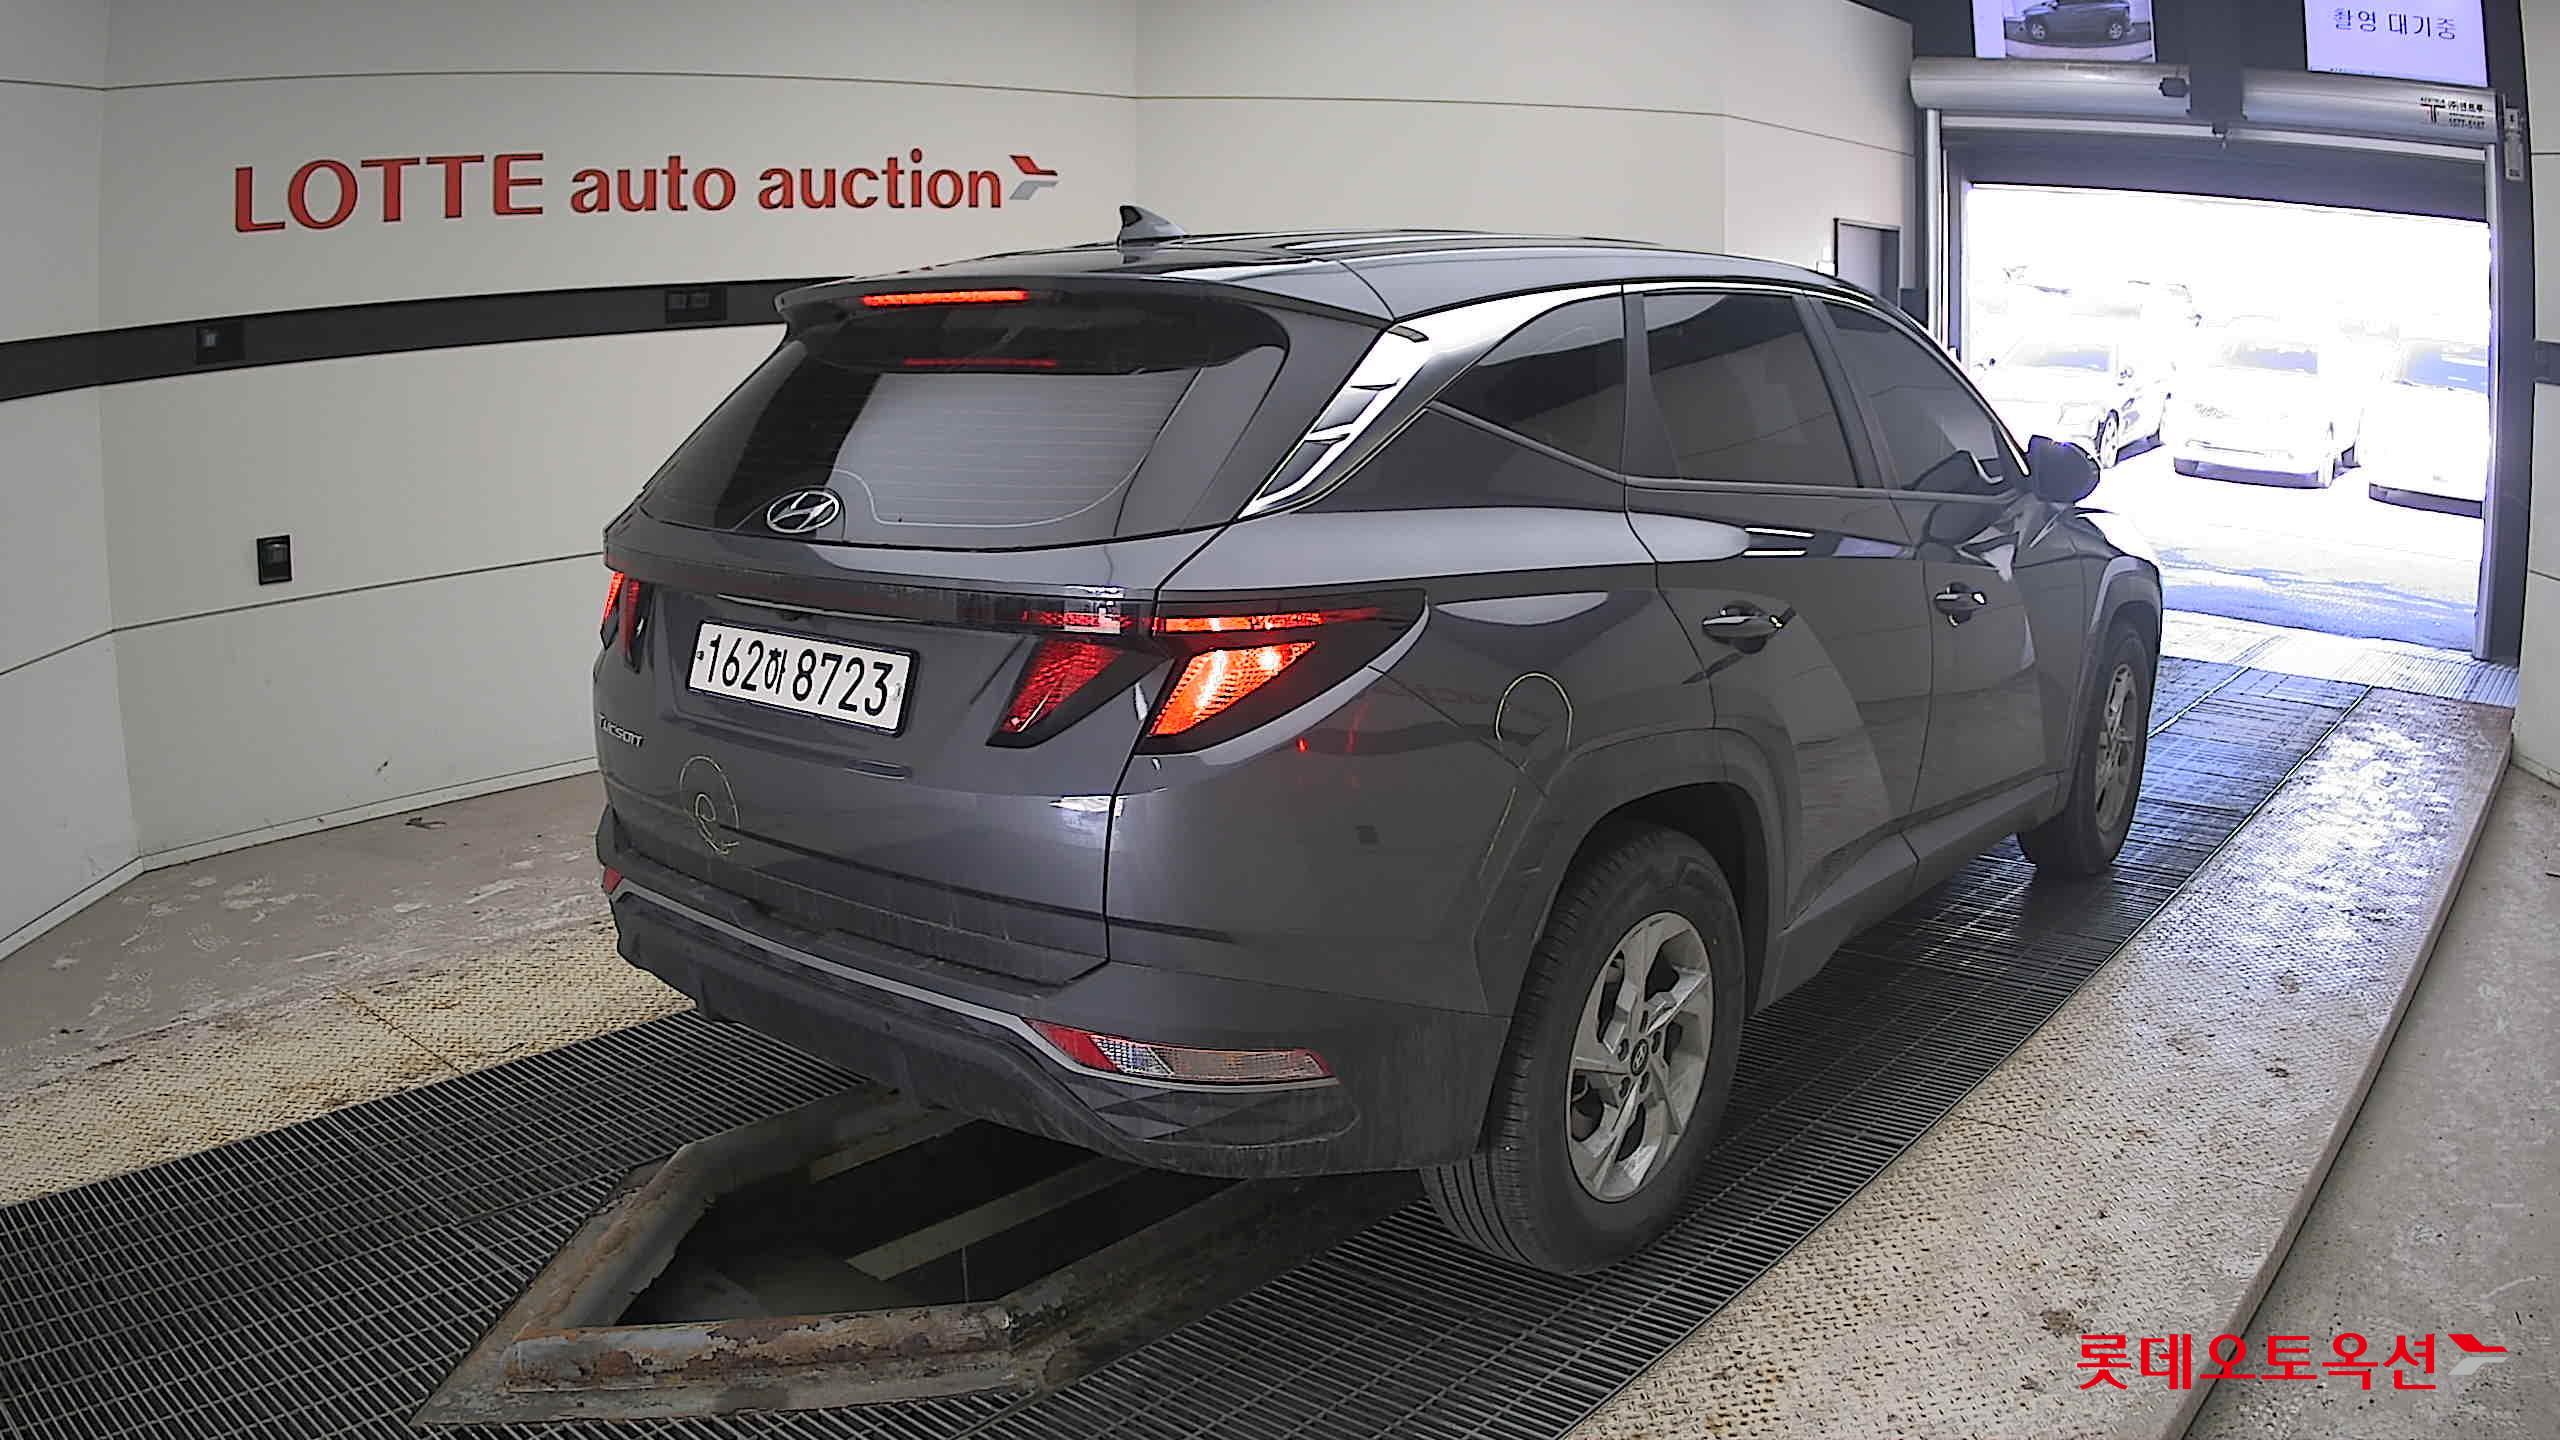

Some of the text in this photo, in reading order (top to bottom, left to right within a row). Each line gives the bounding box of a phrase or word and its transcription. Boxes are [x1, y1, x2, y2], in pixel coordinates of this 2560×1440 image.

[2333, 8, 2456, 40] 촬영 대기중
[234, 148, 1004, 233] LOTTE auto auction
